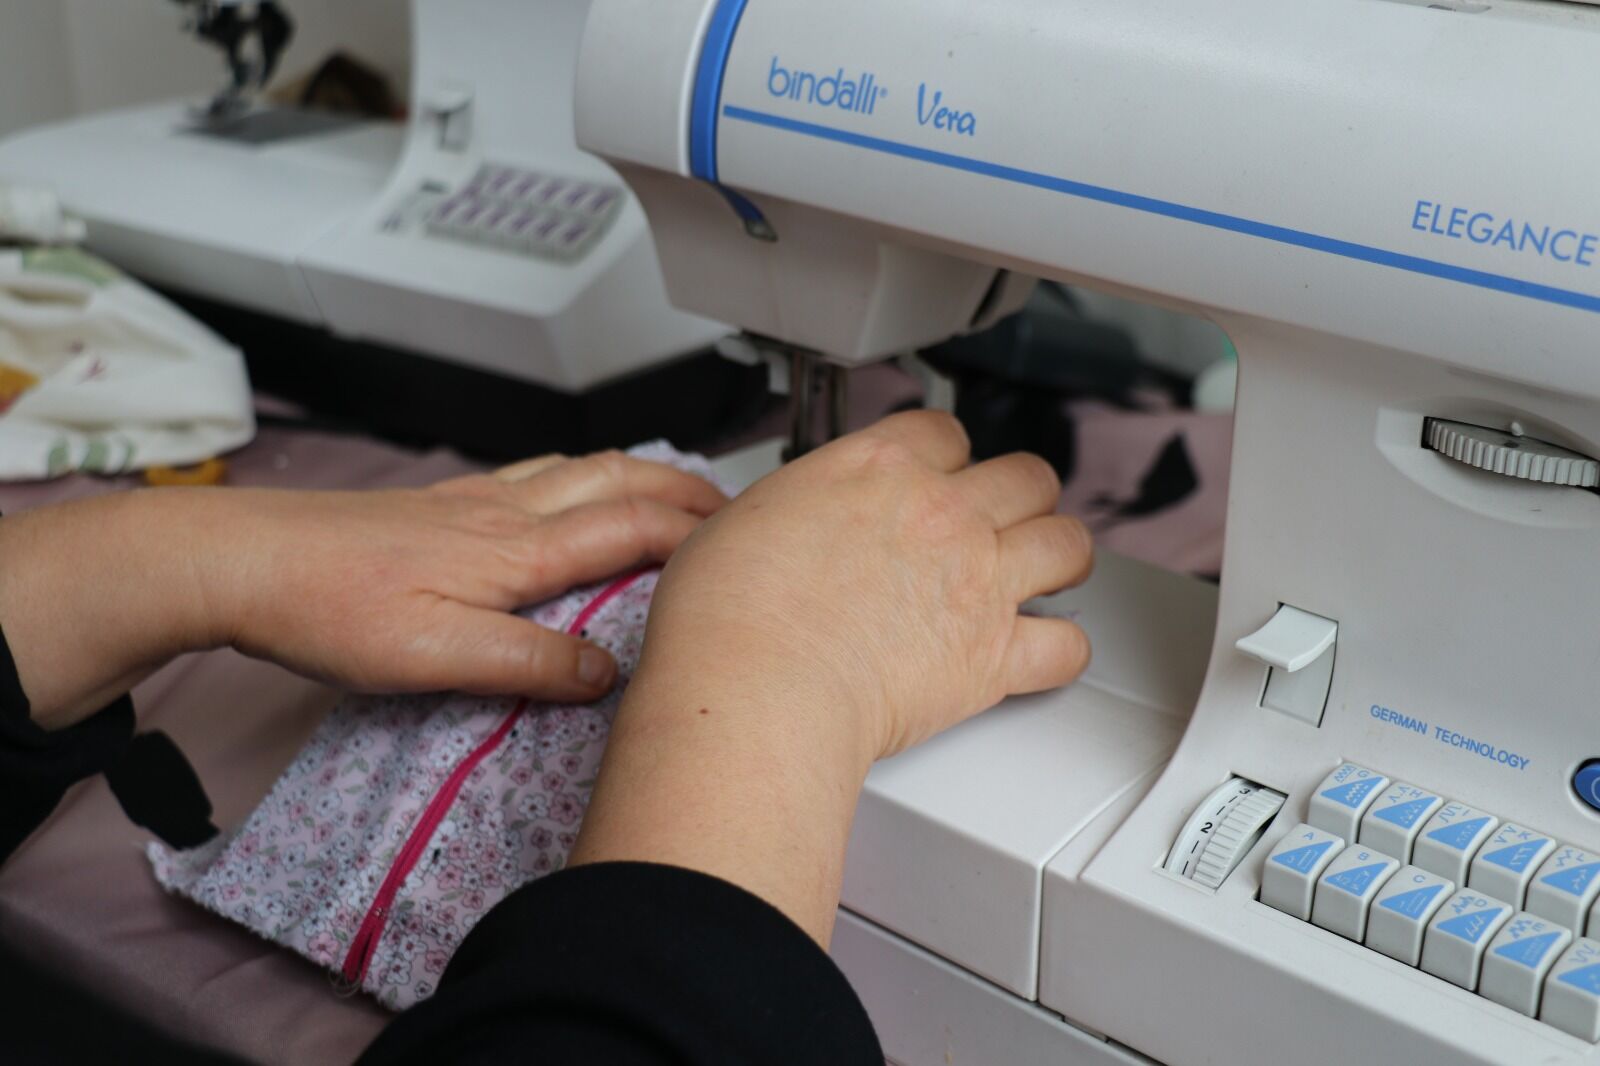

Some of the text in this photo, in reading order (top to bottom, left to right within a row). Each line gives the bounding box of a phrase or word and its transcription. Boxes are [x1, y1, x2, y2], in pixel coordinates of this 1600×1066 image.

[917, 82, 976, 136] Vera
[1411, 200, 1599, 266] ELEGANCE
[1370, 704, 1531, 770] GERMAN TECHNOLOGY
[1239, 787, 1252, 795] 3
[1200, 821, 1213, 834] 2
[1302, 831, 1315, 841] A
[1357, 851, 1370, 861] B
[1412, 874, 1426, 883] C
[1473, 899, 1488, 908] D
